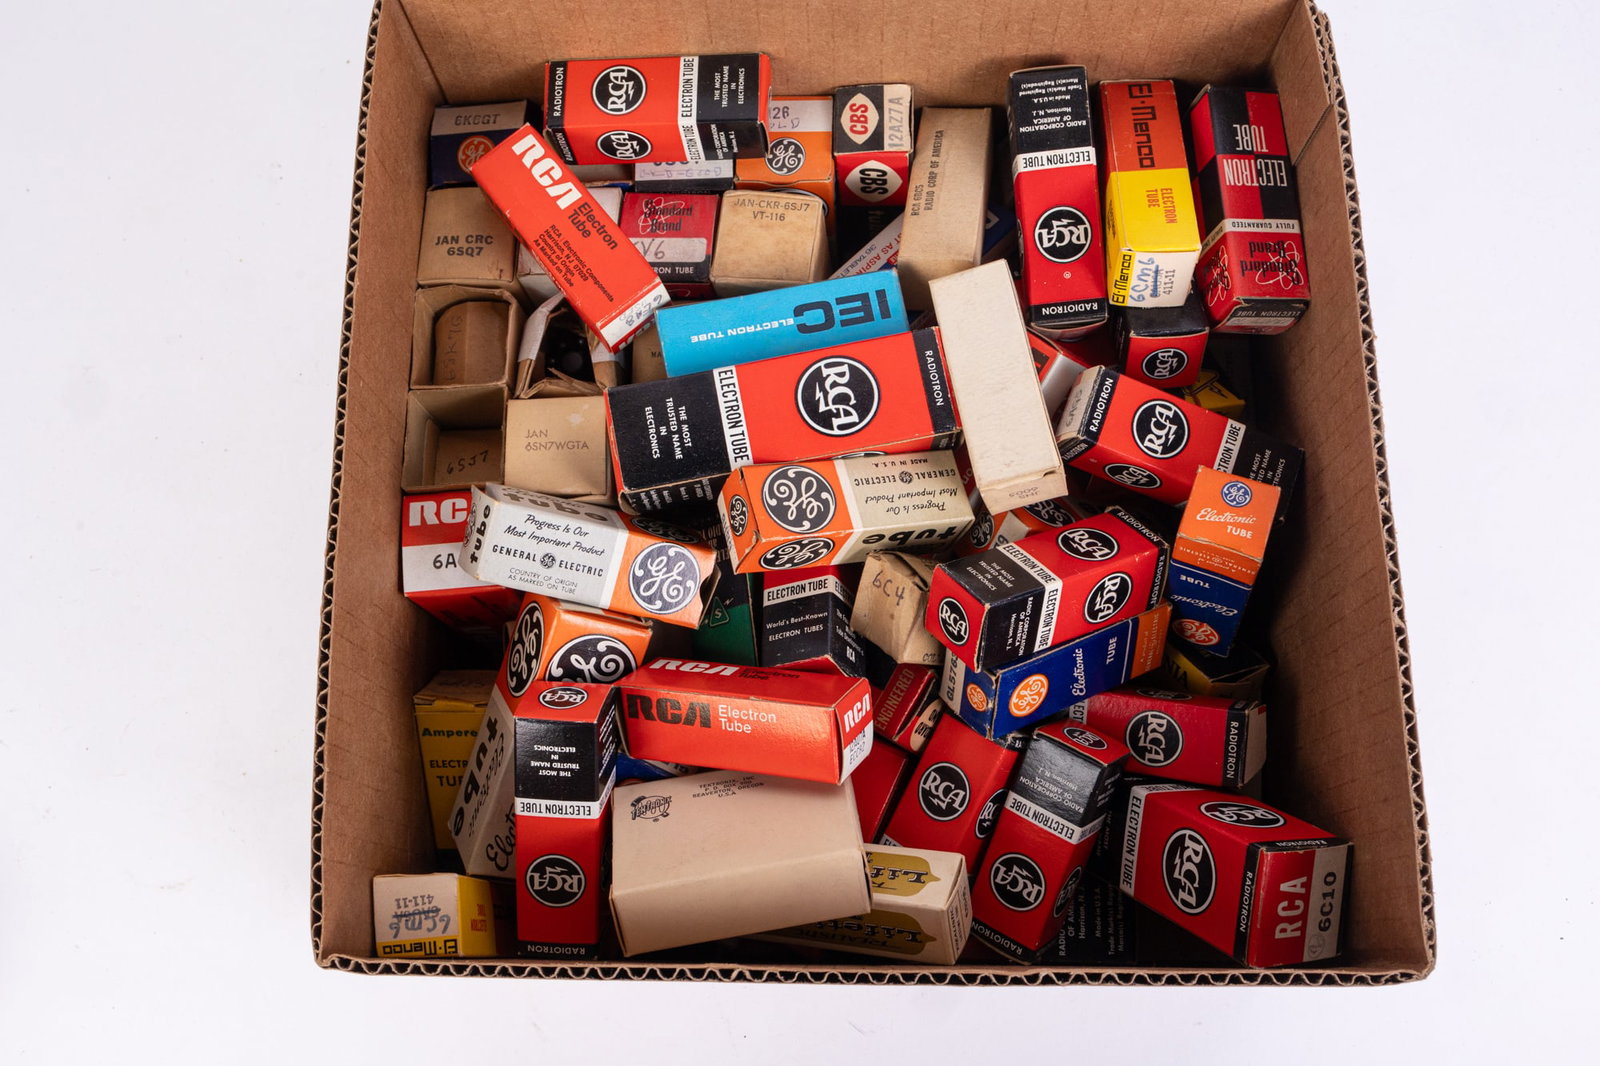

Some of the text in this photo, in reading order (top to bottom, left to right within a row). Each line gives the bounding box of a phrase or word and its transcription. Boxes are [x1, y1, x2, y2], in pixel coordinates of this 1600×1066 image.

[554, 67, 564, 116] RADIOTRON
[608, 68, 629, 112] RCA
[682, 58, 694, 118] ELECTRON TUBE
[732, 82, 736, 90] IN
[850, 103, 869, 134] CBS
[888, 97, 904, 148] 12AZ7A
[1020, 122, 1064, 132] CORPORATION
[1033, 116, 1060, 124] AMERICA
[1233, 124, 1268, 152] TUBE
[512, 134, 582, 210] RCA
[924, 130, 944, 212] AMERICA OF CORP RADIO
[1023, 151, 1091, 168] ELECTRON TUBE
[1223, 158, 1288, 187] ELECTRON
[860, 168, 888, 196] CBS
[1146, 188, 1160, 208] TUBE
[1160, 188, 1178, 224] ELECTRON
[568, 210, 592, 238] Tube
[576, 202, 619, 250] Electron
[752, 210, 786, 222] VT-116
[1231, 221, 1296, 230] FULLY GUARANTEED
[435, 233, 494, 246] JAN CRC
[1038, 220, 1091, 248] RCA
[446, 245, 484, 258] 6SQ7
[563, 236, 586, 267] Electronic
[675, 266, 694, 275] TUBE
[794, 288, 891, 334] IEC
[1042, 301, 1098, 316] RADIOTRON
[690, 317, 794, 342] ELECTRON TUBE
[1154, 349, 1174, 378] RCA
[925, 350, 944, 406] RADIOTRON
[824, 364, 858, 432] RCA
[1090, 378, 1114, 433] RADIOTRON
[666, 397, 684, 460] TRUSTED NAME
[678, 406, 692, 447] THE MOST
[718, 369, 749, 463] ELECTRON TUBE
[1144, 405, 1175, 454] RCA
[525, 429, 548, 439] JAN
[644, 406, 660, 459] ELECTRONICS
[660, 426, 668, 436] IN
[1226, 424, 1241, 445] TUBE
[525, 440, 590, 452] 6SN7WGTA
[446, 450, 489, 475] 6SJ7
[854, 468, 956, 486] GENERAL ELECTRIC
[865, 488, 958, 504] Most Important Product
[886, 500, 946, 516] Progress Our
[409, 498, 470, 527] RC
[524, 514, 590, 538] Progress Is Our
[1117, 511, 1160, 542] RADIOTRON
[1196, 508, 1256, 524] Electronic
[470, 504, 491, 564] tube
[504, 525, 605, 557] Most Important Product
[862, 526, 957, 546] tube
[1068, 530, 1111, 560] RCA
[1226, 525, 1254, 540] TUBE
[492, 544, 604, 577] GENERAL ELECTRIC
[978, 560, 998, 576] TRUSTED
[1003, 545, 1056, 584] ELECTRON TUBE
[510, 568, 578, 588] COUNTRY OF ORIGIN
[519, 576, 544, 588] MARKED
[547, 582, 558, 590] ON
[561, 586, 576, 596] TUBE
[767, 579, 828, 602] ELECTRON TUBE
[872, 571, 905, 607] 6C4
[966, 566, 998, 591] ELECTRONICS
[1180, 574, 1211, 589] TUBE
[1099, 577, 1121, 621] RCA
[1171, 594, 1238, 616] Electronic
[766, 611, 828, 630] World's Best-Known
[942, 604, 966, 634] RCA
[1018, 596, 1034, 656] RADIO CORPORATION
[1038, 588, 1058, 648] ELECTRON TUBE
[768, 624, 824, 642] ELECTRON TUBES
[1015, 620, 1024, 646] AMERICA
[846, 646, 856, 663] RCA
[1106, 636, 1118, 664] TUBE
[648, 659, 740, 676] RCA
[1072, 647, 1086, 698] Electronic
[626, 694, 712, 729] RCA
[844, 692, 871, 734] RCA
[874, 668, 914, 731] ENGINEERED
[718, 704, 778, 724] Electron
[719, 717, 752, 734] Tube
[422, 728, 477, 738] Ampere
[1146, 713, 1168, 762] RCA
[534, 744, 576, 752] ELECTRONICS
[1228, 720, 1239, 779] RADIOTRON
[551, 762, 580, 770] TRUSTED
[922, 772, 966, 810] RCA
[1019, 776, 1063, 803] CORPORATION
[520, 802, 592, 816] TUBE ELECTRON
[1010, 797, 1031, 818] TUBE
[1031, 806, 1076, 840] ELECTRON
[1122, 795, 1141, 888] ELECTRON TUBE
[532, 866, 582, 893] RCA
[870, 865, 928, 884] Lif
[995, 860, 1043, 904] RCA
[1178, 834, 1205, 906] RCA
[1240, 871, 1254, 933] RADIOTRON
[1274, 876, 1308, 939] RCA
[1318, 871, 1337, 933] 6C10
[528, 944, 586, 955] RADIOTRON
[971, 920, 1024, 956] RADIOTRON
